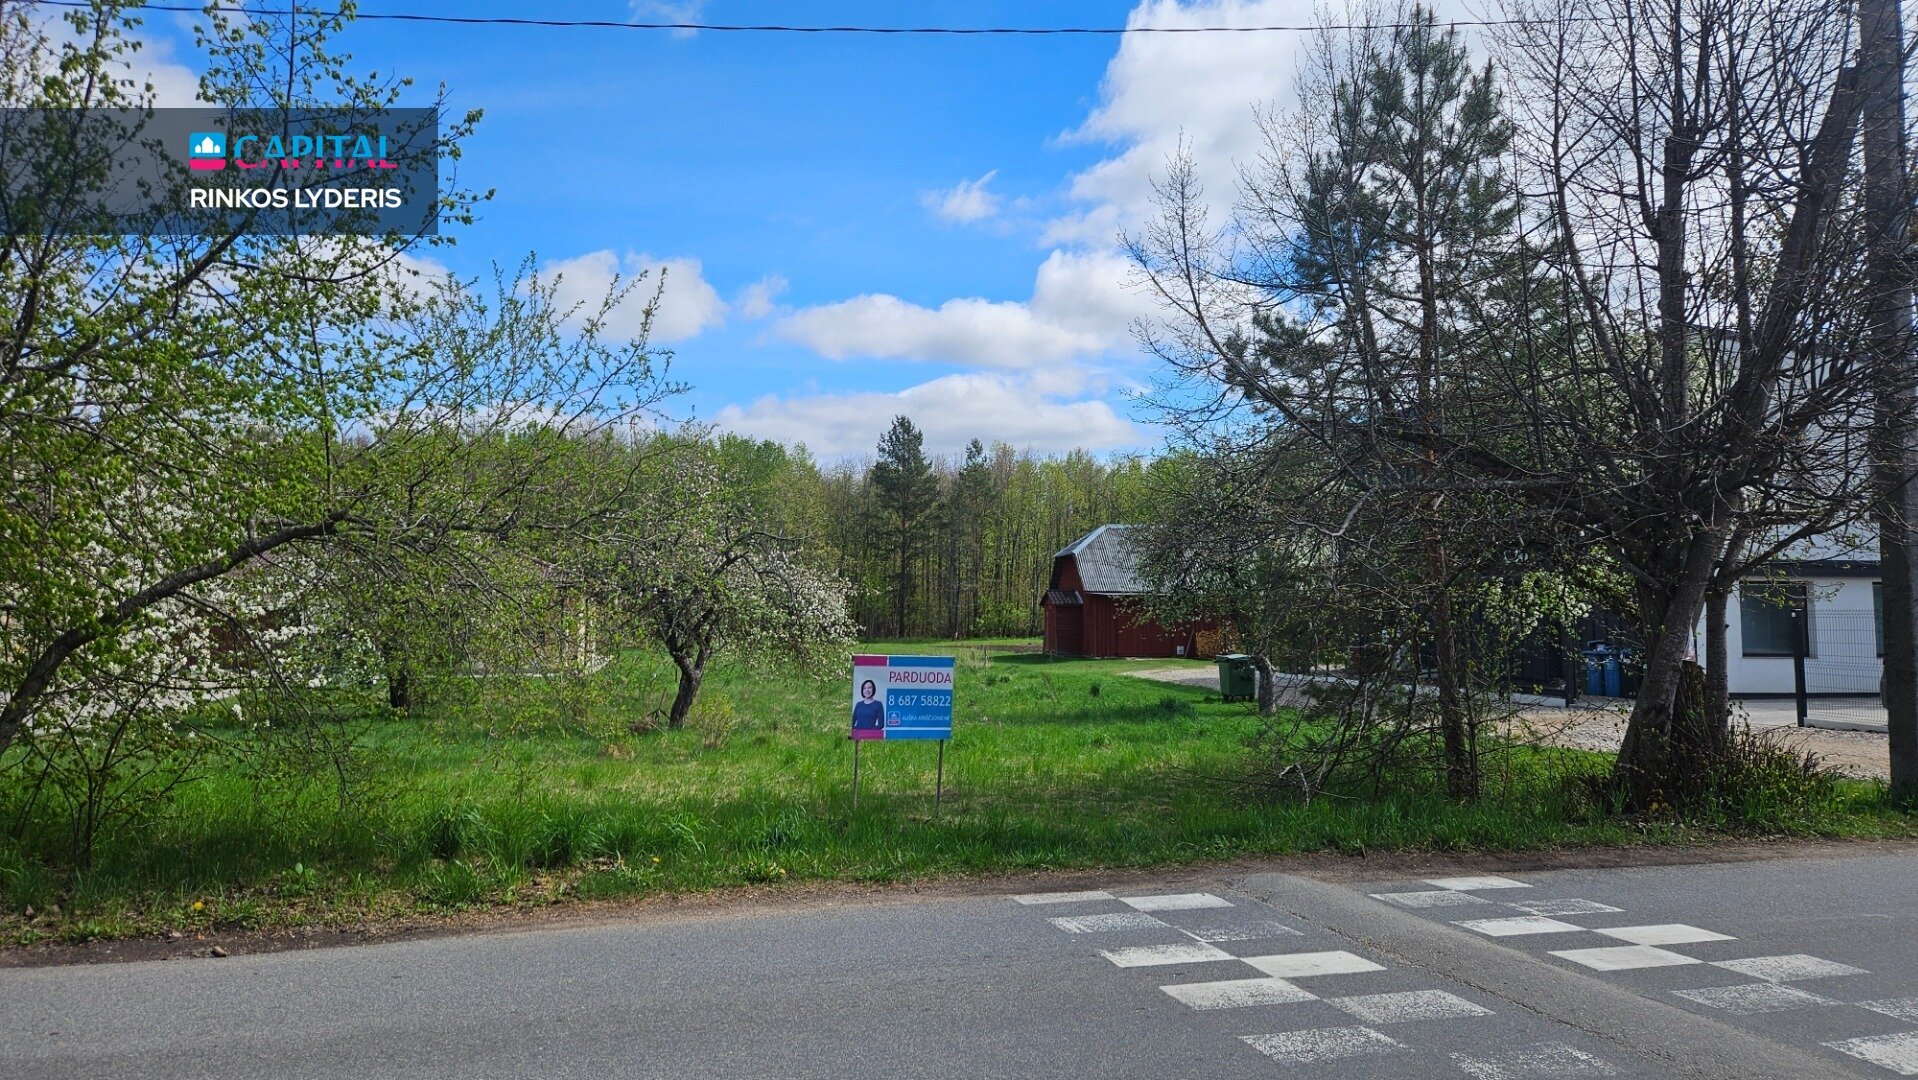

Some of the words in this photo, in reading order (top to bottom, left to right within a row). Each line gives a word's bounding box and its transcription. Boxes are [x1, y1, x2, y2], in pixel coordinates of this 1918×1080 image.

[889, 671, 952, 683] PARDUODA
[888, 695, 895, 706] 8
[898, 695, 918, 706] 687
[921, 695, 951, 707] 58822
